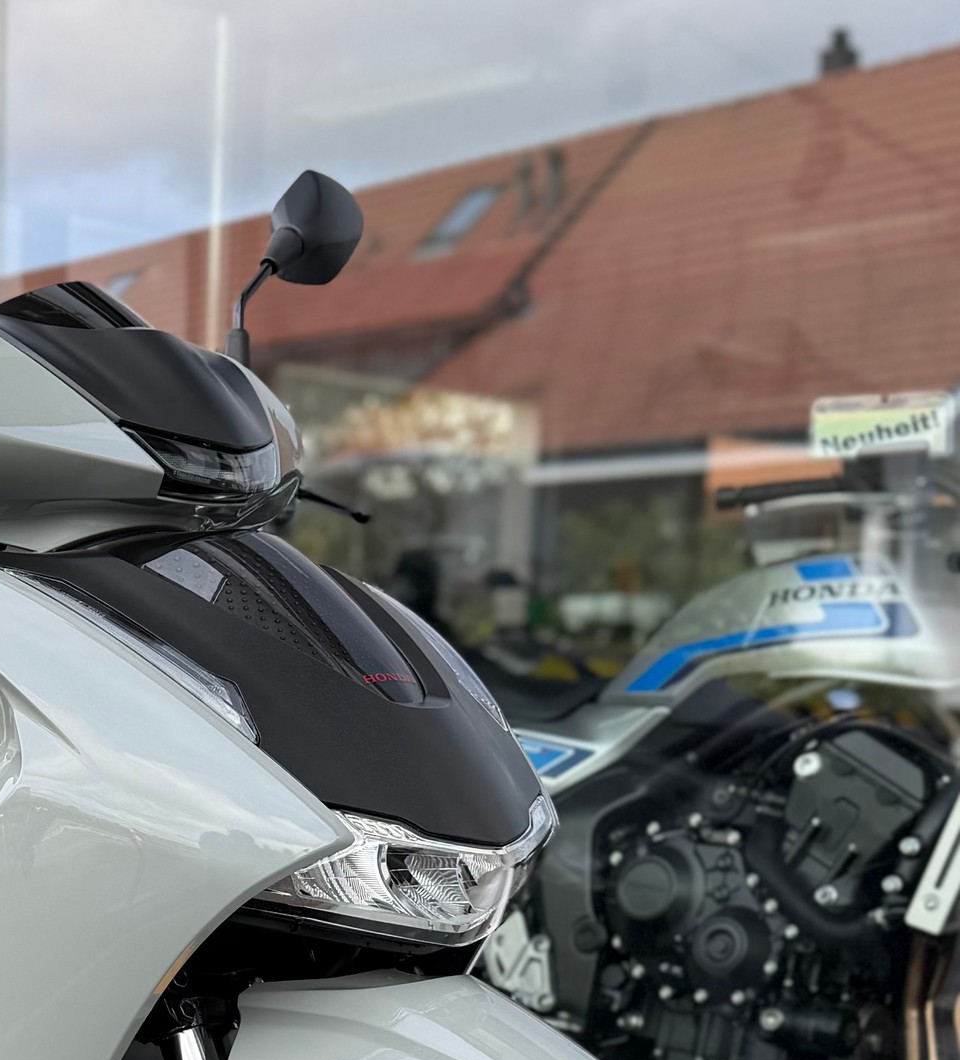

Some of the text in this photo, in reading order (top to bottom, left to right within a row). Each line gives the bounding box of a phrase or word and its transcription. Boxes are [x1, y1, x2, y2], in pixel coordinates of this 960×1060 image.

[820, 409, 940, 456] Neuheit!
[768, 582, 901, 607] HONDA
[362, 672, 416, 685] HONDA
